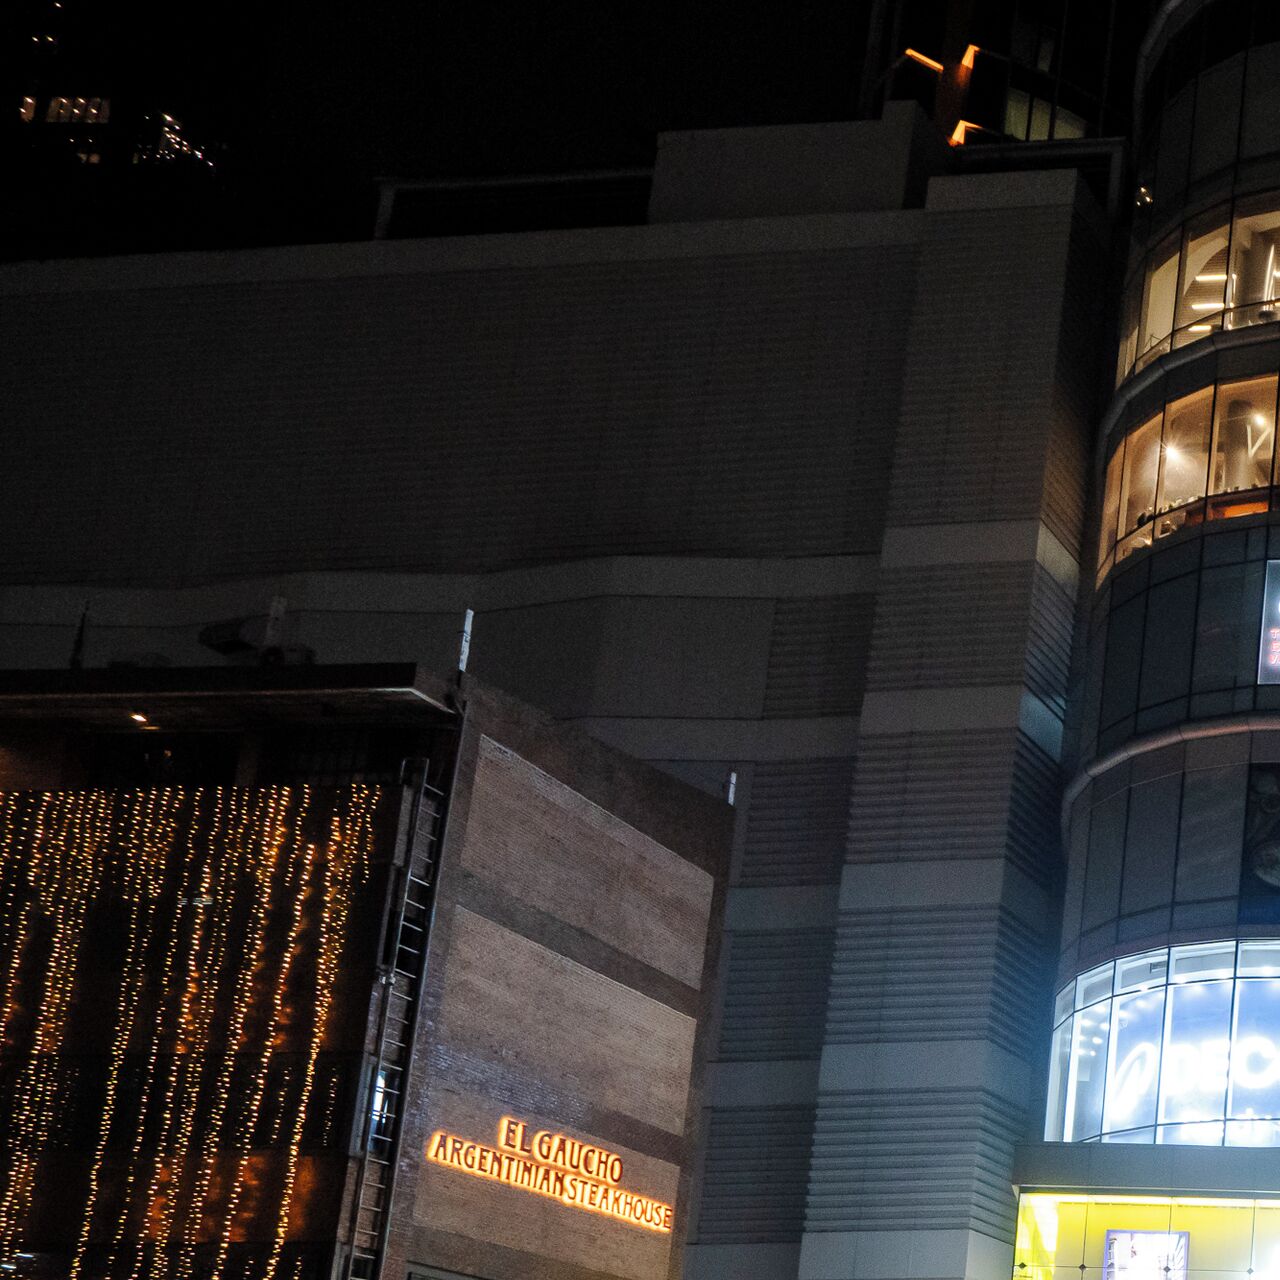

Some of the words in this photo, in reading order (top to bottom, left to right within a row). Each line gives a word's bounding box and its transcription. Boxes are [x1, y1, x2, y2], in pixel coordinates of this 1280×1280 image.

[434, 1134, 564, 1197] ARGENTINIAN
[567, 1177, 673, 1230] STEAKHOUSE
[504, 1119, 531, 1154] EL
[537, 1133, 624, 1184] GAUCHO
